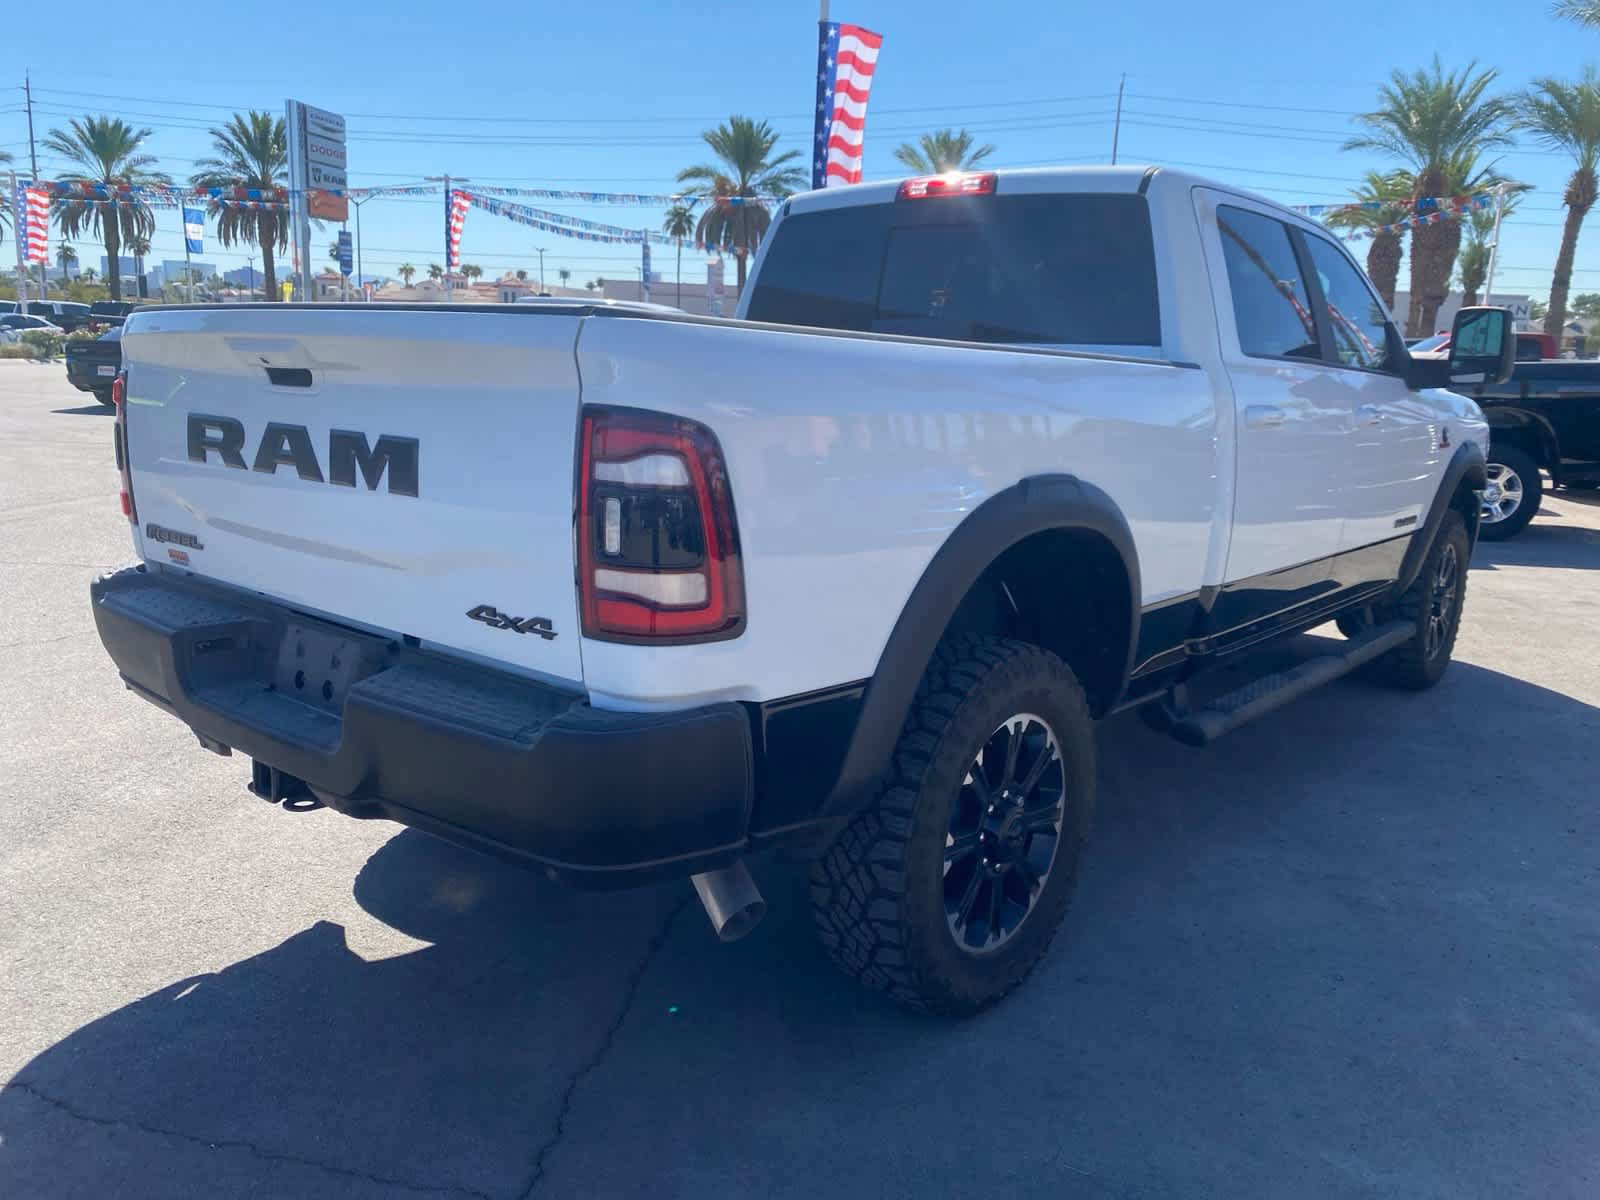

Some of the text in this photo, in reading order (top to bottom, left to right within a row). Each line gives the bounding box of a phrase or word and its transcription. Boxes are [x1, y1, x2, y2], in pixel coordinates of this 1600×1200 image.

[310, 144, 345, 159] DODGE
[323, 174, 346, 186] RAM
[187, 411, 420, 498] RAM
